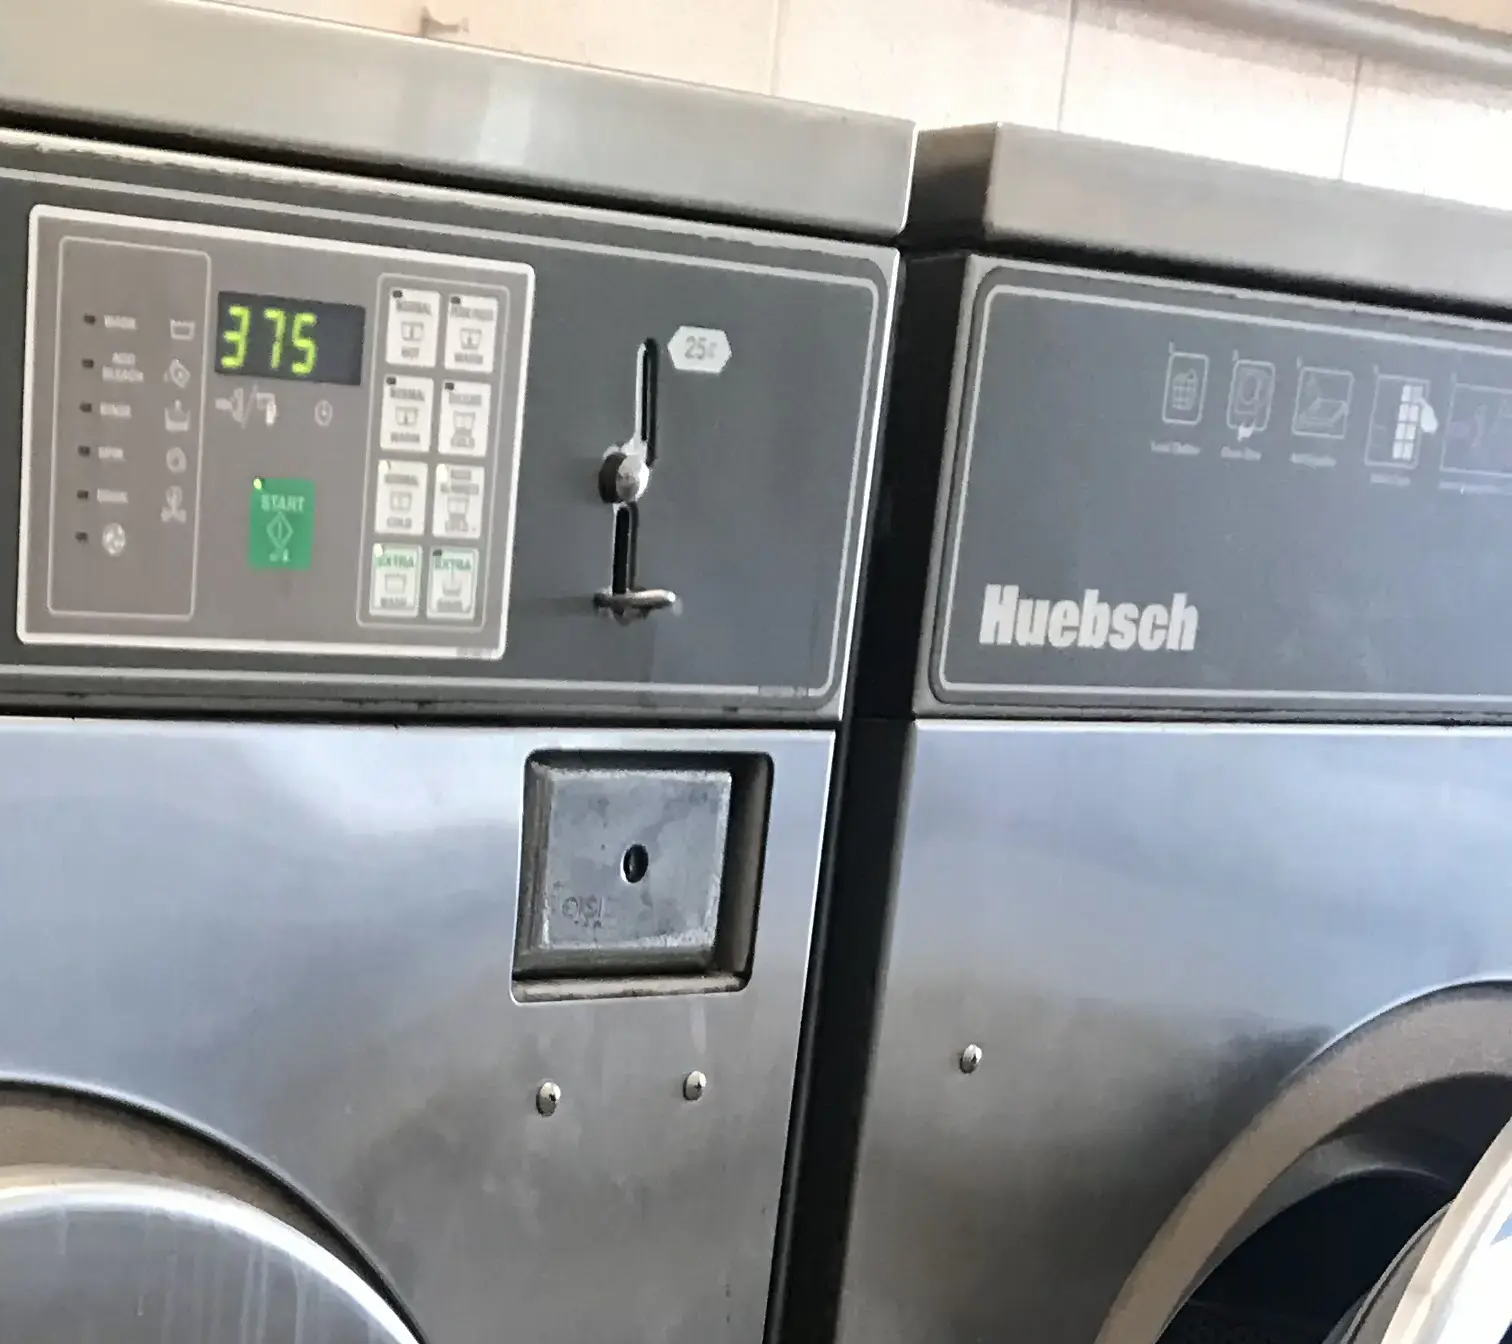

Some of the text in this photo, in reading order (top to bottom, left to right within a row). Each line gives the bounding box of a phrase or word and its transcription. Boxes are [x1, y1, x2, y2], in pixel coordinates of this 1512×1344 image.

[221, 304, 317, 375] 375
[261, 494, 305, 512] START
[979, 584, 1199, 651] Huebsch
